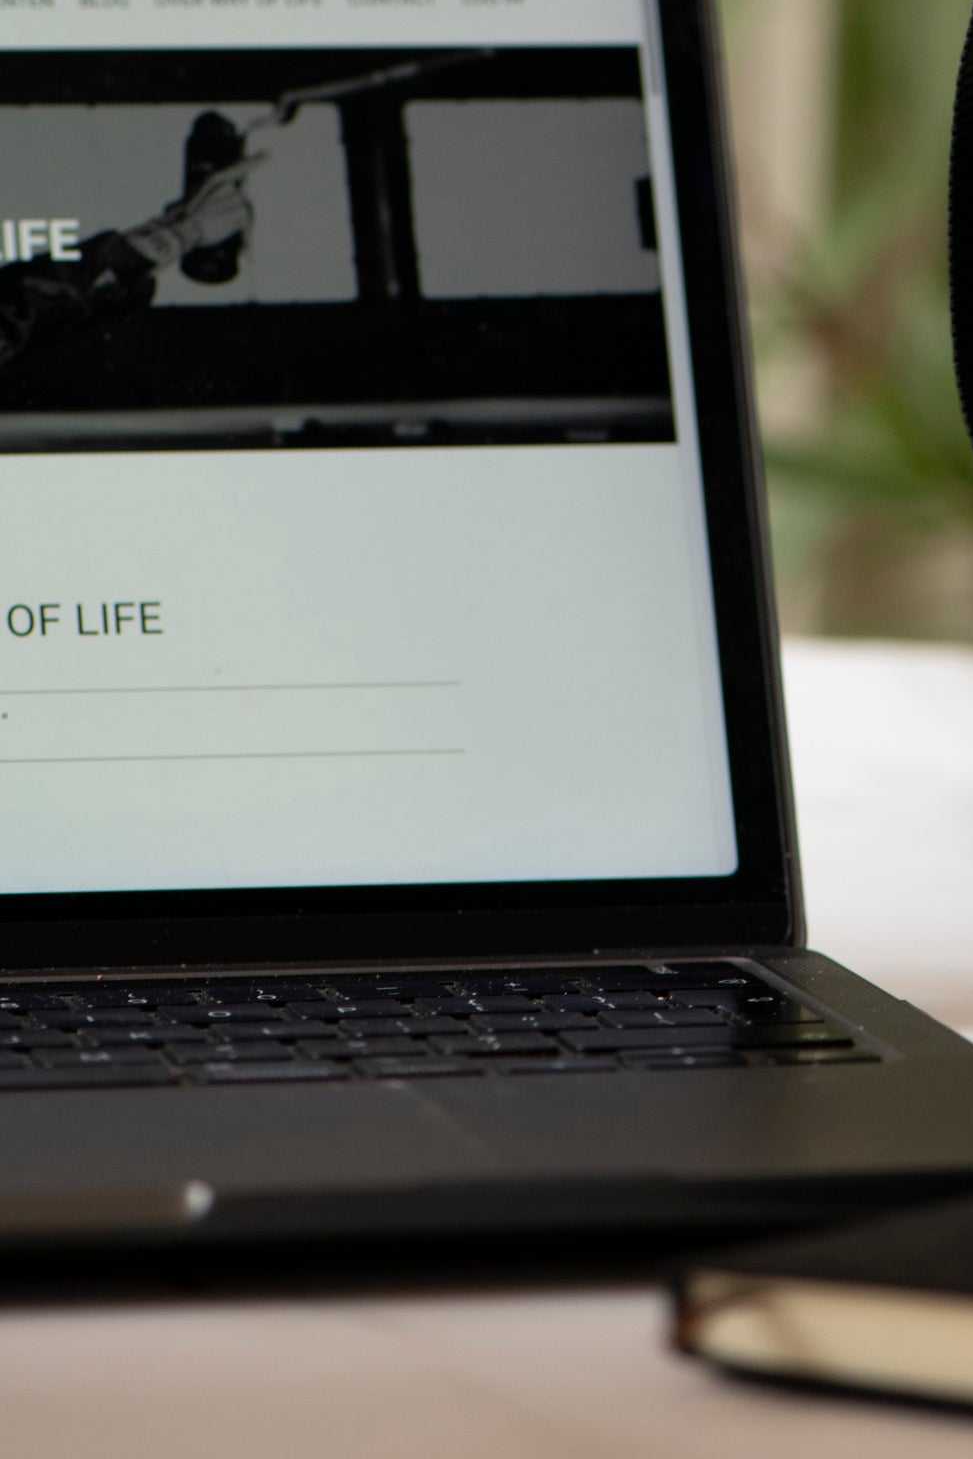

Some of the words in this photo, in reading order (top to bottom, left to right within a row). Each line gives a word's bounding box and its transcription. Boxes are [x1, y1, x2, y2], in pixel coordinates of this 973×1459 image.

[0, 219, 82, 261] IFE
[7, 603, 60, 637] OF
[76, 601, 163, 636] LIFE
